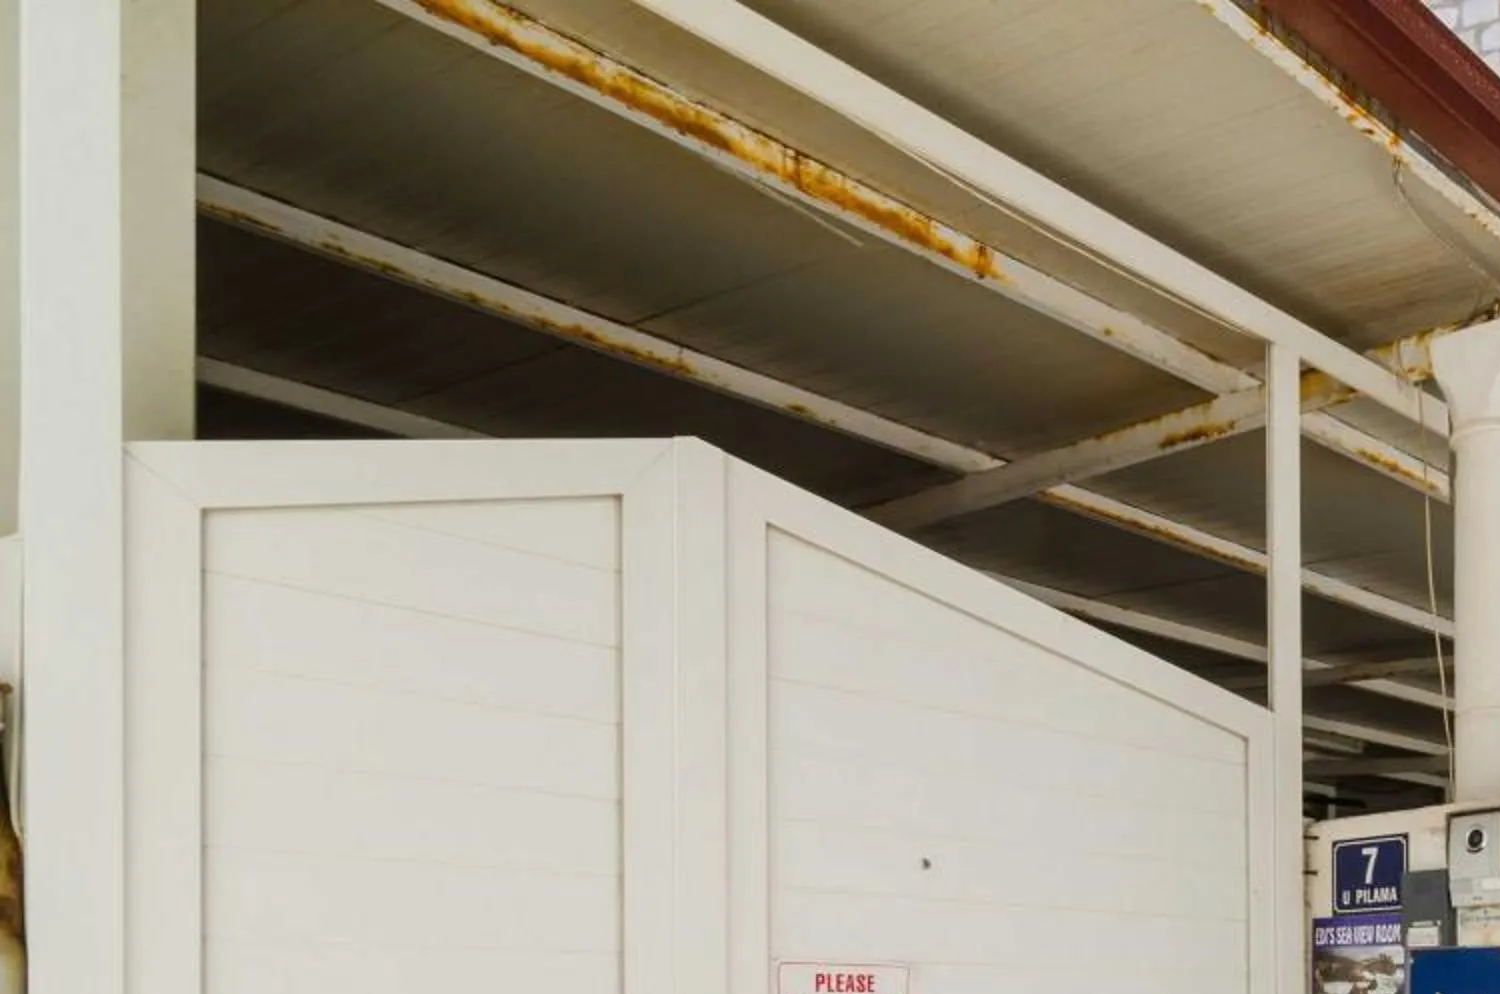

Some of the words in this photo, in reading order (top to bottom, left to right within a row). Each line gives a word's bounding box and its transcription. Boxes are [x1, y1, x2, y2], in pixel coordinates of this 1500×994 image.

[1361, 846, 1379, 885] 7
[1342, 889, 1351, 905] U
[1355, 886, 1398, 905] PILAMA
[815, 973, 875, 993] PLEASE
